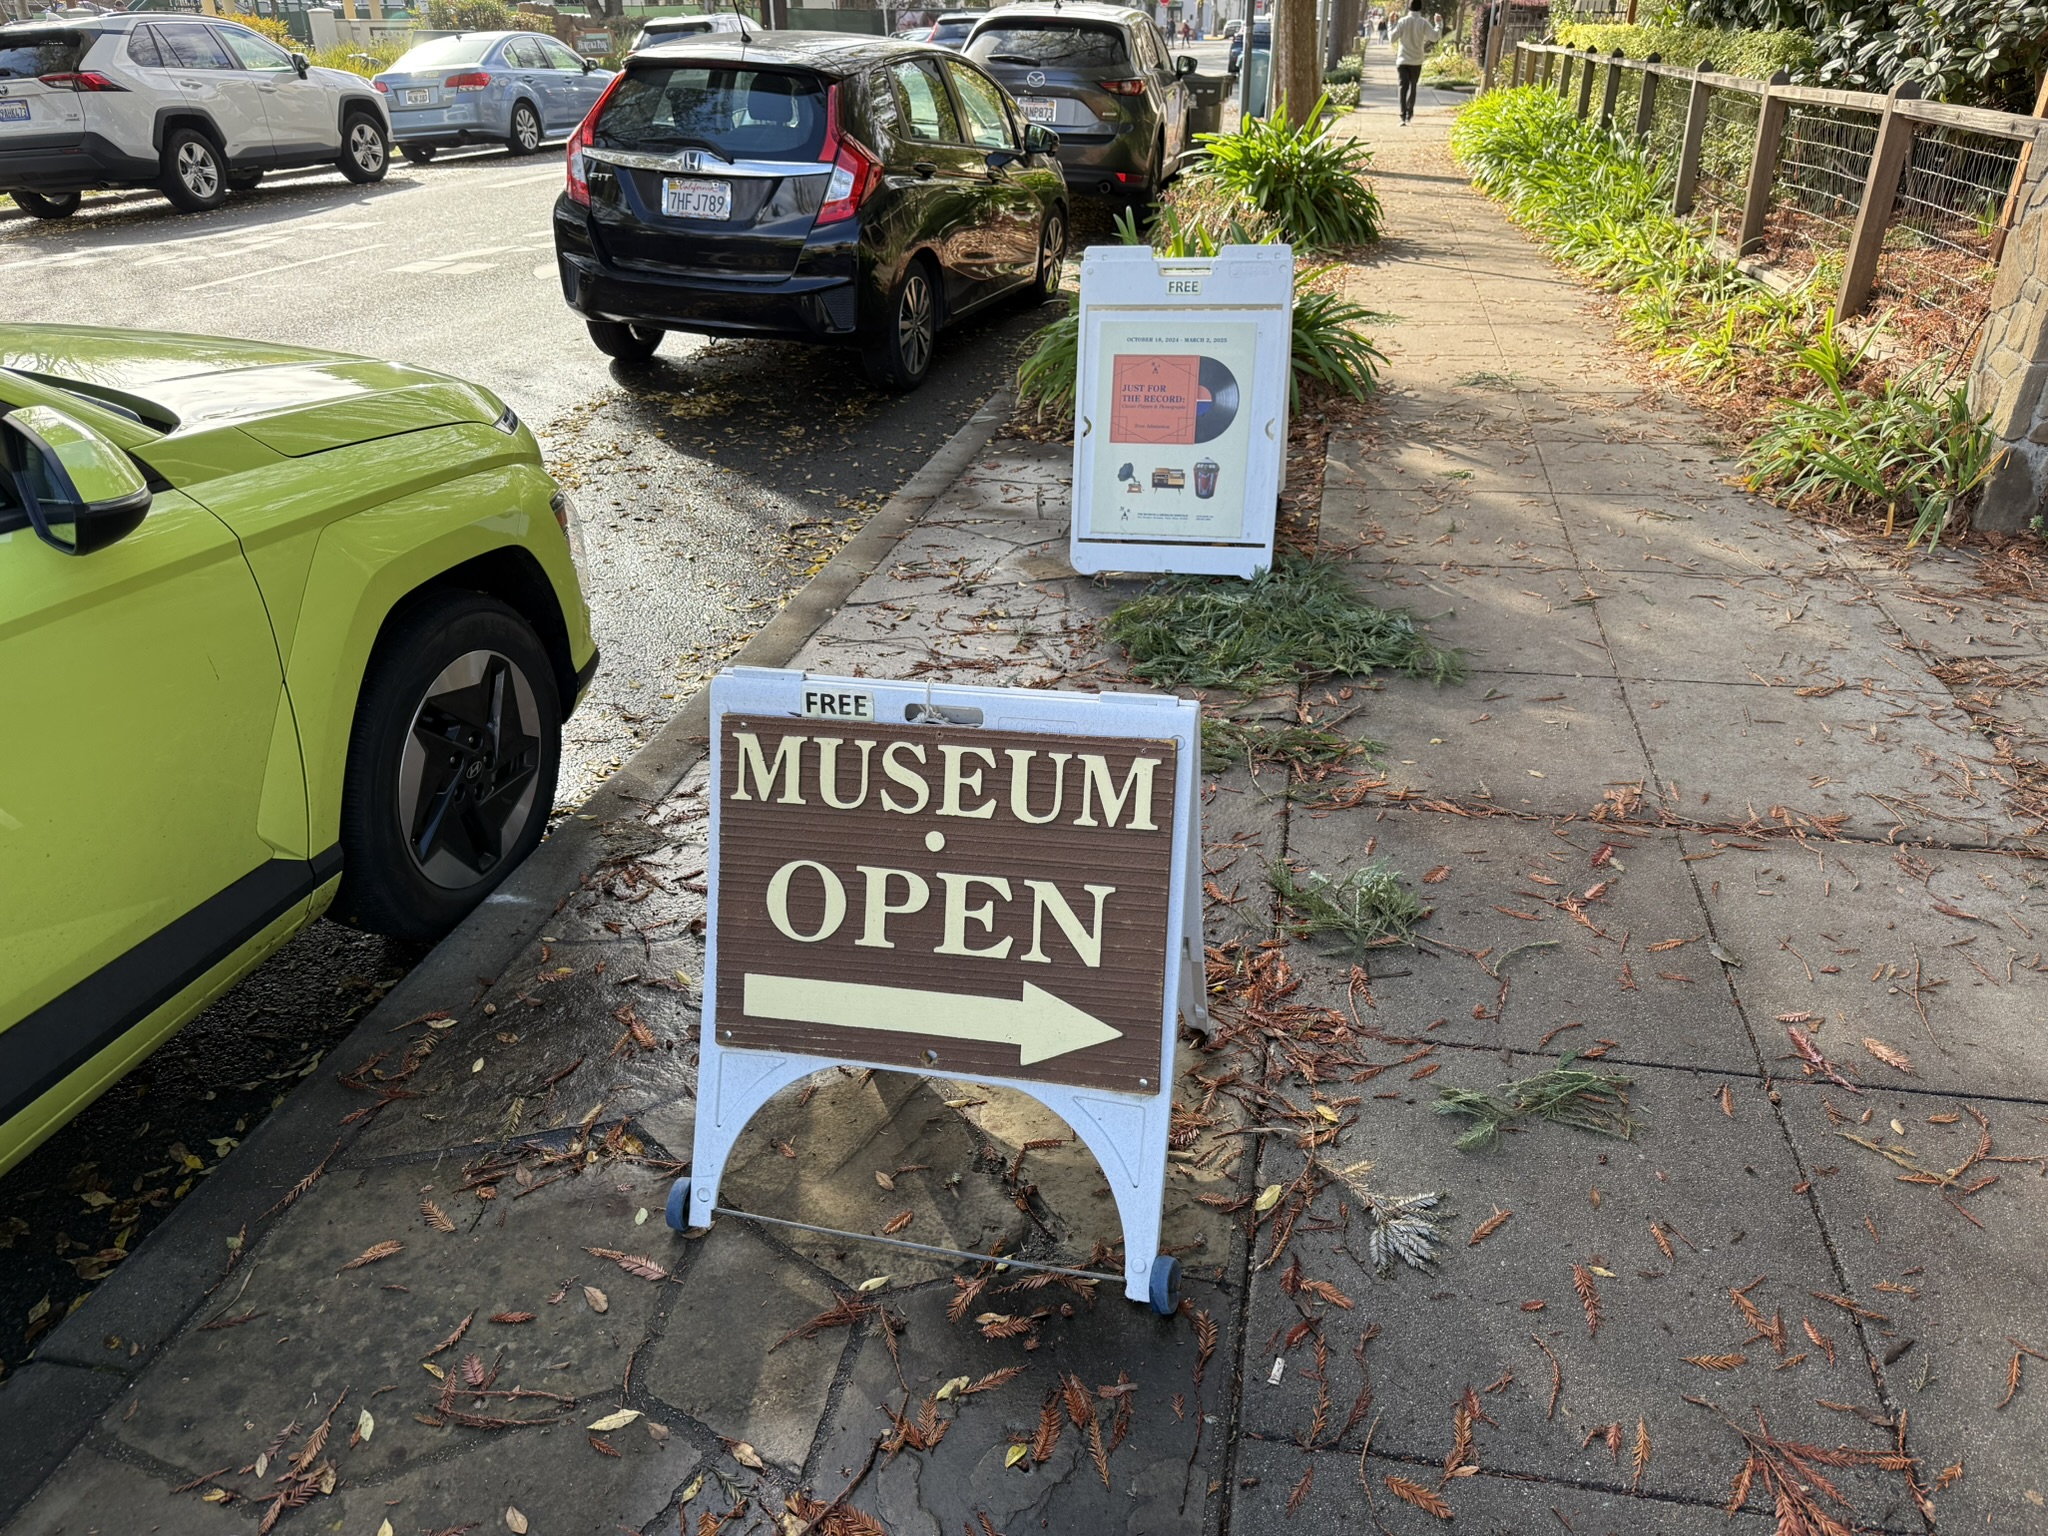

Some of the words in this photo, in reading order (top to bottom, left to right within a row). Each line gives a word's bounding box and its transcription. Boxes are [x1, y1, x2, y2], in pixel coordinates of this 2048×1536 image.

[588, 172, 613, 181] FIT
[679, 182, 719, 193] California
[670, 191, 725, 214] 7HFJ789
[1168, 281, 1199, 293] FREE
[1122, 384, 1145, 392] JUST
[1147, 385, 1167, 393] FOR
[1122, 394, 1141, 403] THE
[1144, 395, 1185, 403] RECORD:
[805, 692, 869, 718] FREE
[730, 732, 1162, 831] MUSEUM
[766, 860, 1116, 968] OPEN
